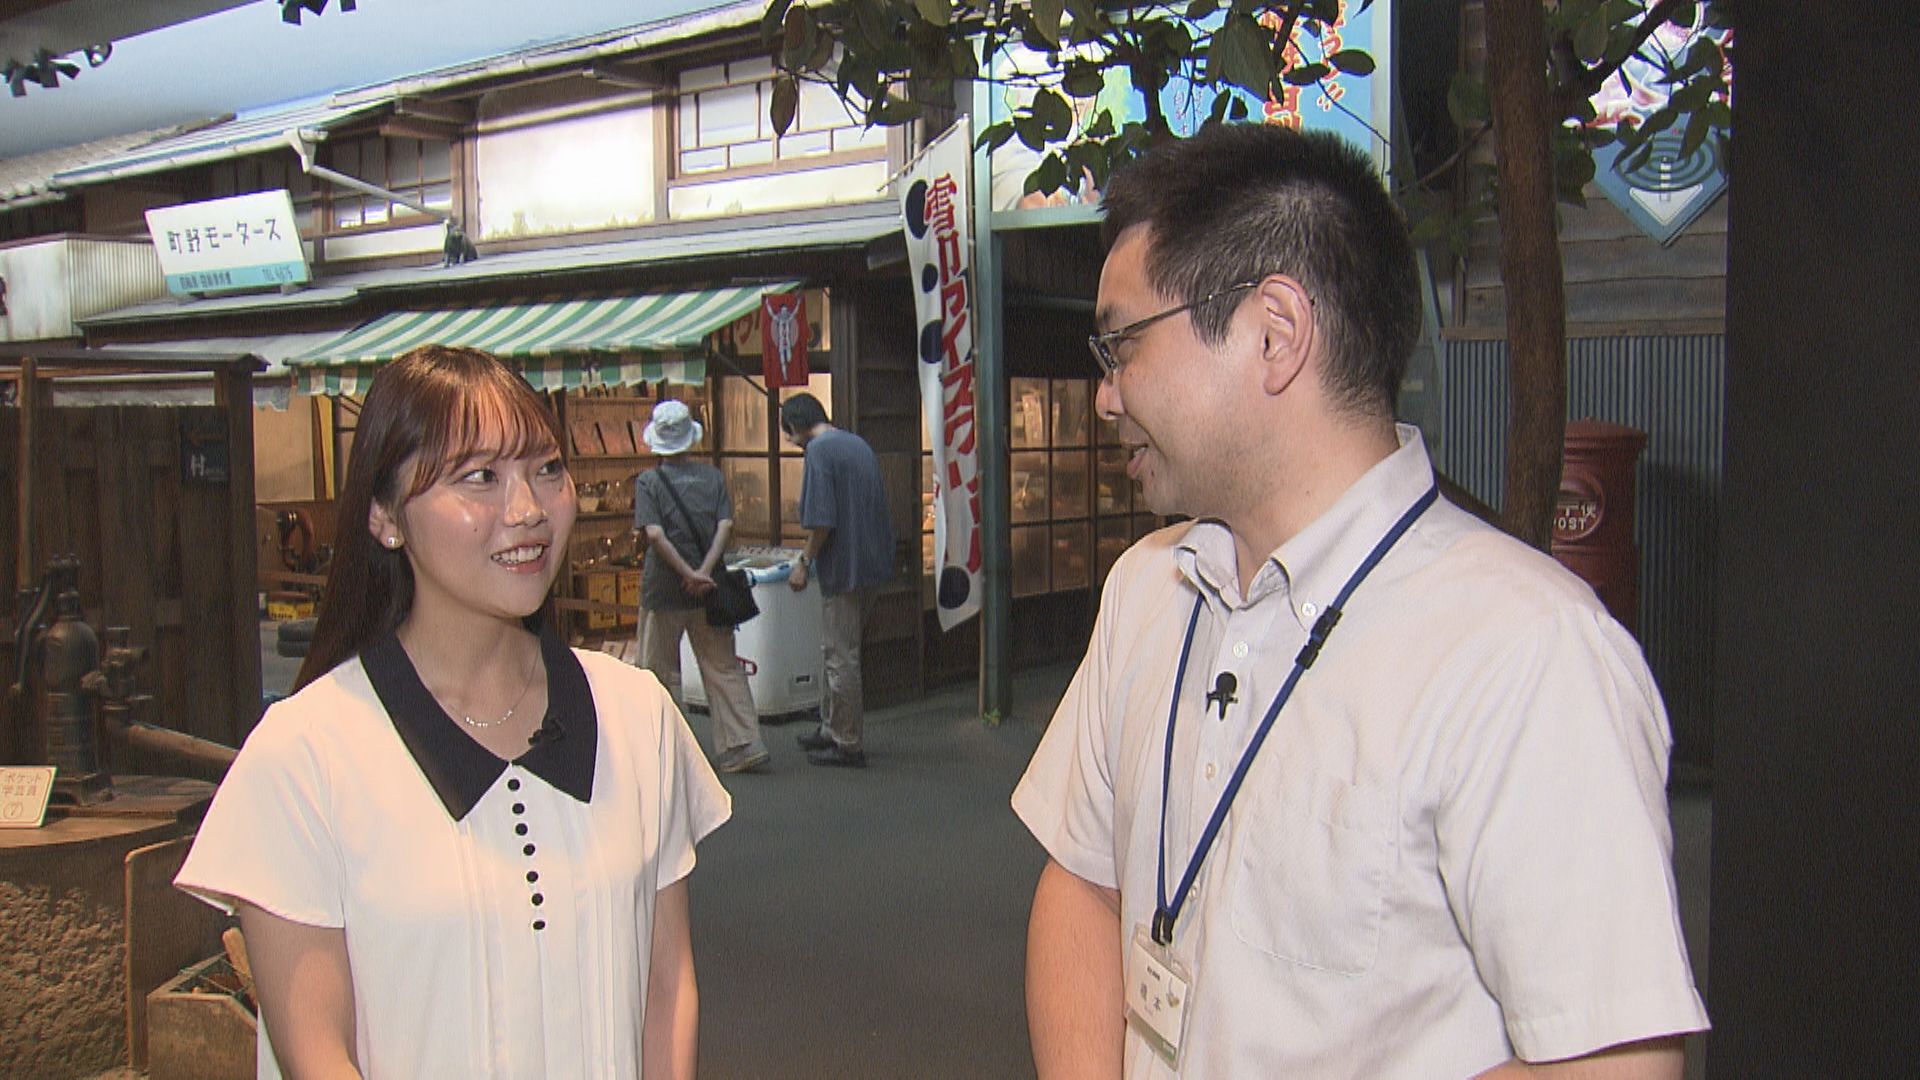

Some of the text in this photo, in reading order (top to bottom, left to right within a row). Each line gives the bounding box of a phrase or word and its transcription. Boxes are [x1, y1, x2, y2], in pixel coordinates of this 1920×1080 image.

[167, 218, 281, 254] 町野モータース
[1553, 517, 1585, 531] OST
